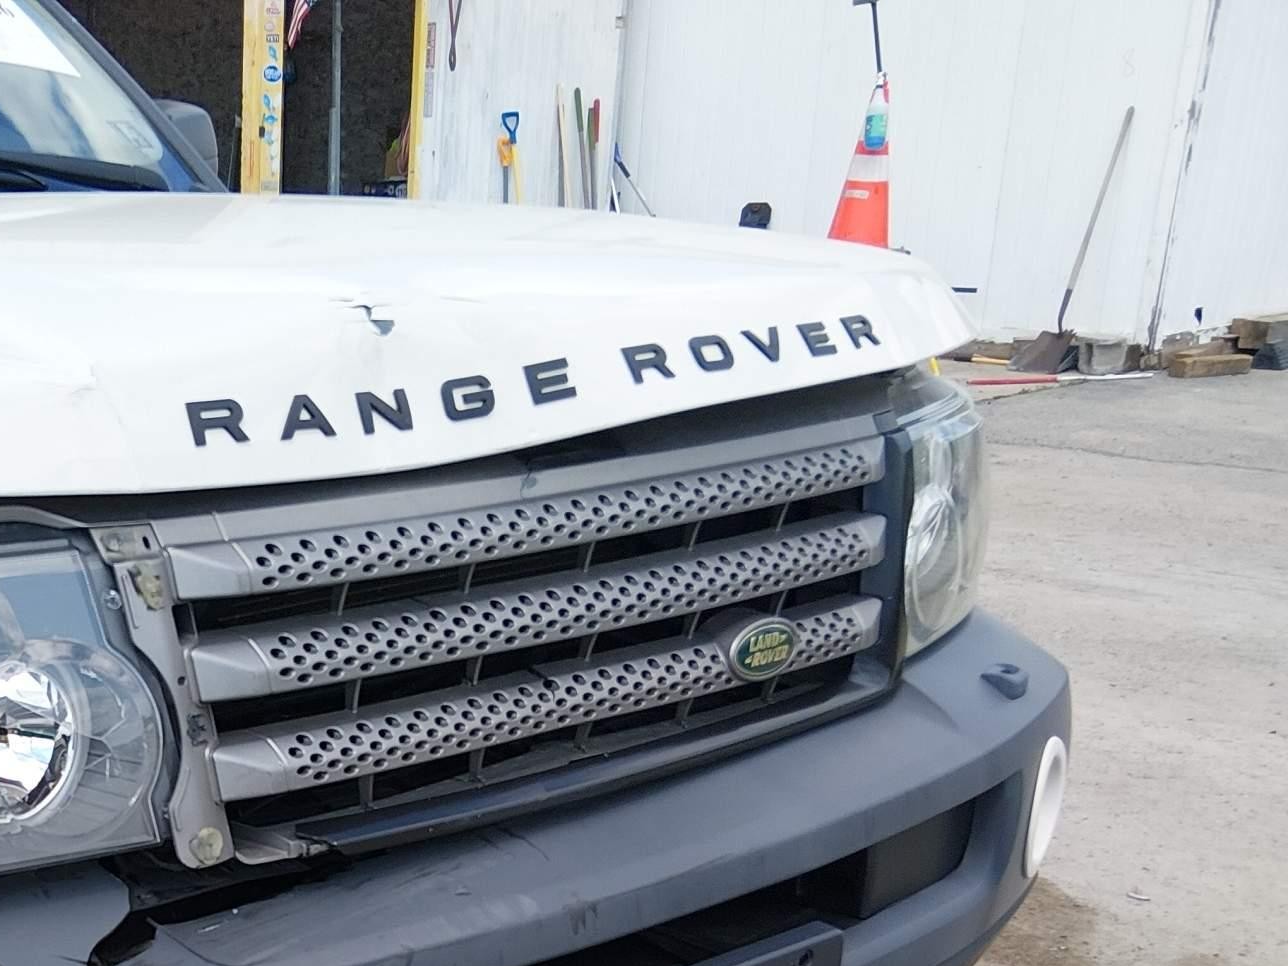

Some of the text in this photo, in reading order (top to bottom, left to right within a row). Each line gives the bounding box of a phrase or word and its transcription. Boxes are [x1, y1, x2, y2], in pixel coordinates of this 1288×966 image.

[185, 314, 882, 447] RANGE ROVER
[749, 632, 780, 653] LAND
[751, 645, 789, 667] ROVER
